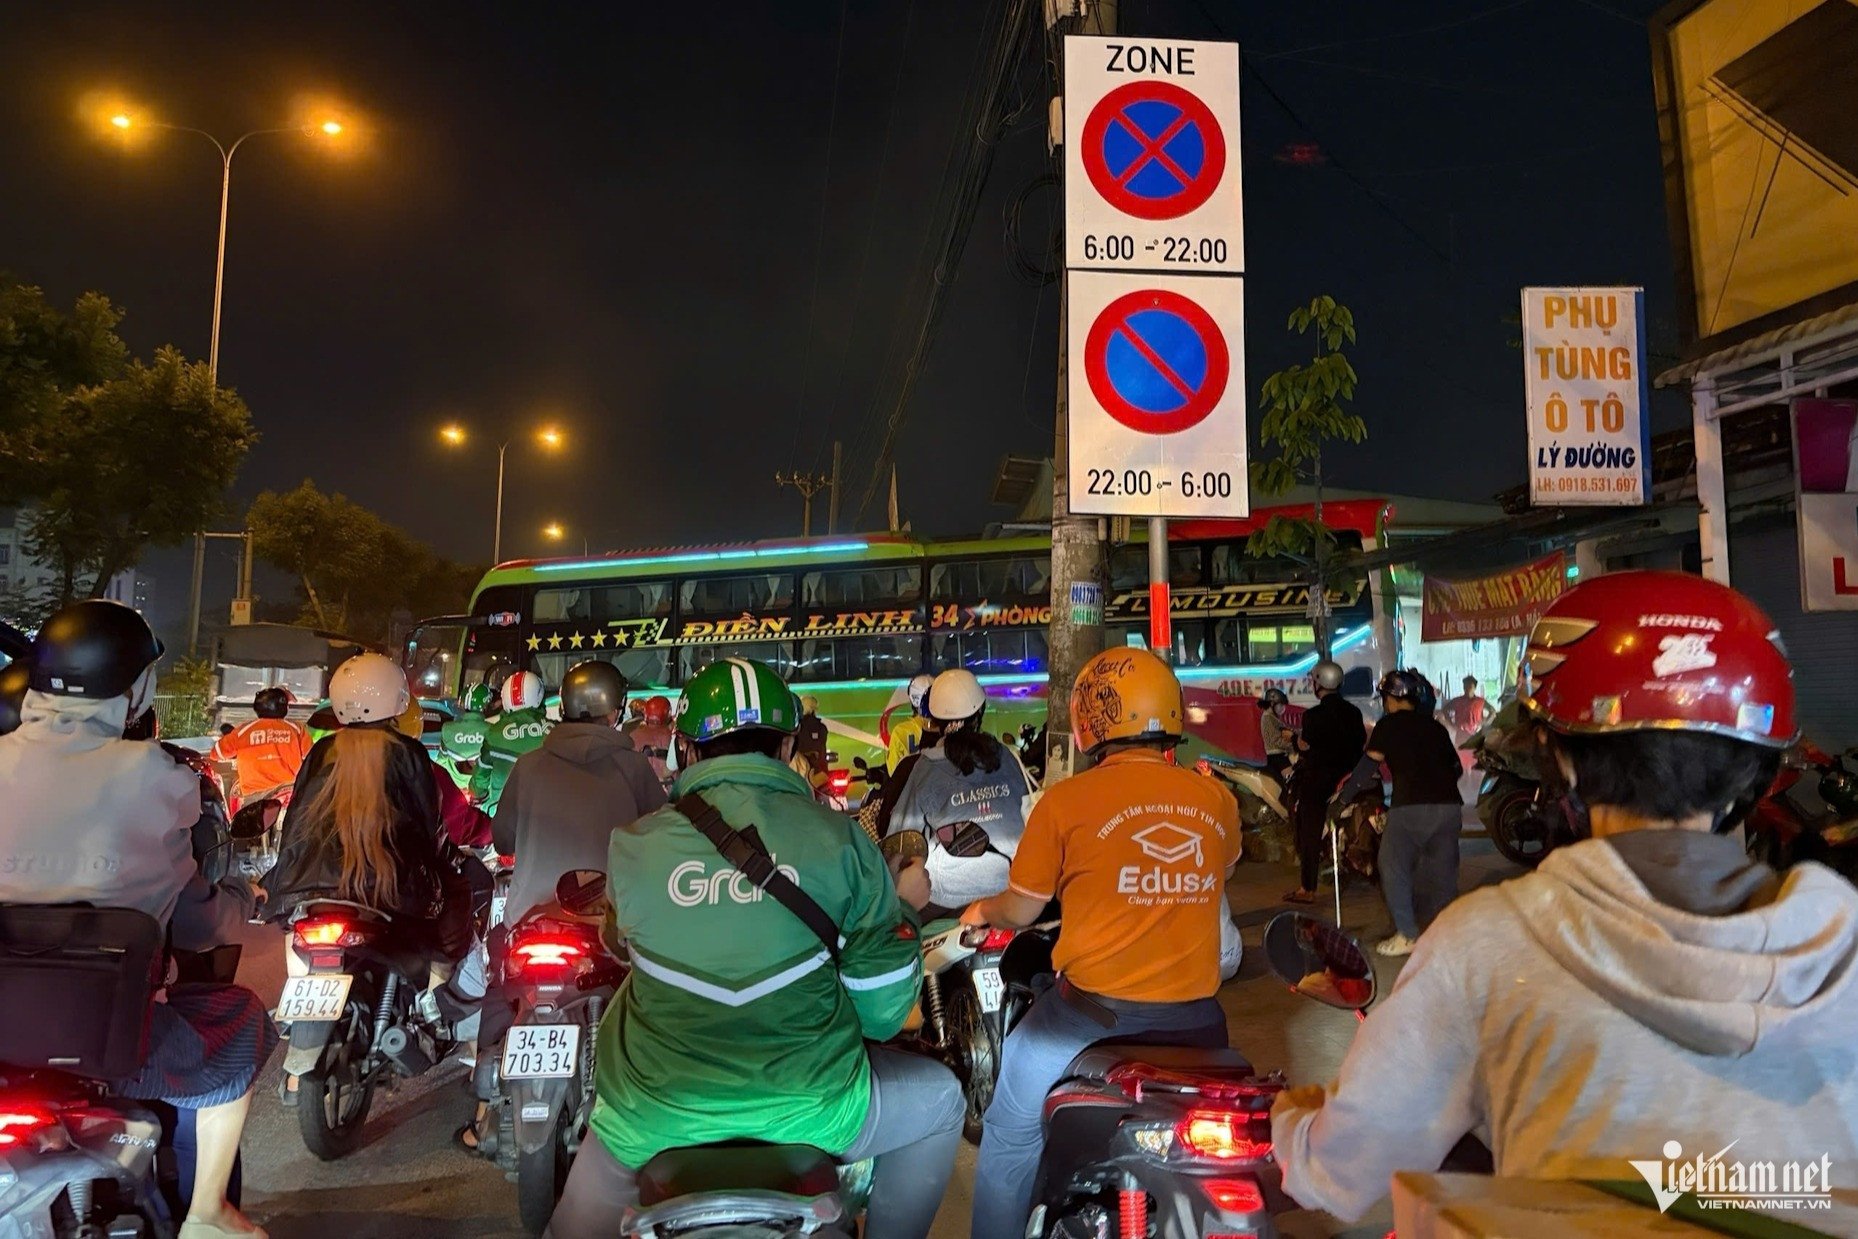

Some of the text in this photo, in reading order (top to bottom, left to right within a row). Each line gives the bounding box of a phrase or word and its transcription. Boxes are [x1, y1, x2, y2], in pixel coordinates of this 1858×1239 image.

[1106, 45, 1196, 76] ZONE
[1084, 235, 1135, 261] 6:00
[1163, 237, 1228, 264] 22:00
[1544, 296, 1618, 336] PHỤ
[1535, 340, 1632, 381] TÙNG
[1545, 392, 1625, 433] Ô TÔ
[1537, 440, 1636, 469] LÝ ĐƯỜNG
[1087, 469, 1152, 497] 22:00
[1181, 471, 1232, 498] 6:00
[1537, 477, 1638, 492] LH: 0918.531.697
[1131, 588, 1343, 612] LMOUSINE
[681, 611, 792, 638] ĐIỀN
[804, 609, 917, 632] LINH
[930, 604, 959, 629] 34
[980, 604, 1051, 627] PHÒNG
[1638, 613, 1724, 632] HONDA
[267, 735, 291, 744] Food
[454, 731, 484, 744] Grab
[951, 783, 1011, 807] CLASSICS
[1096, 813, 1124, 841] TRUNG
[1122, 804, 1143, 820] TÂM
[1200, 810, 1216, 826] TIN
[294, 979, 341, 998] 61-D2
[284, 998, 340, 1017] 159.44
[517, 1029, 568, 1050] 34-B4
[508, 1052, 571, 1075] 703.34
